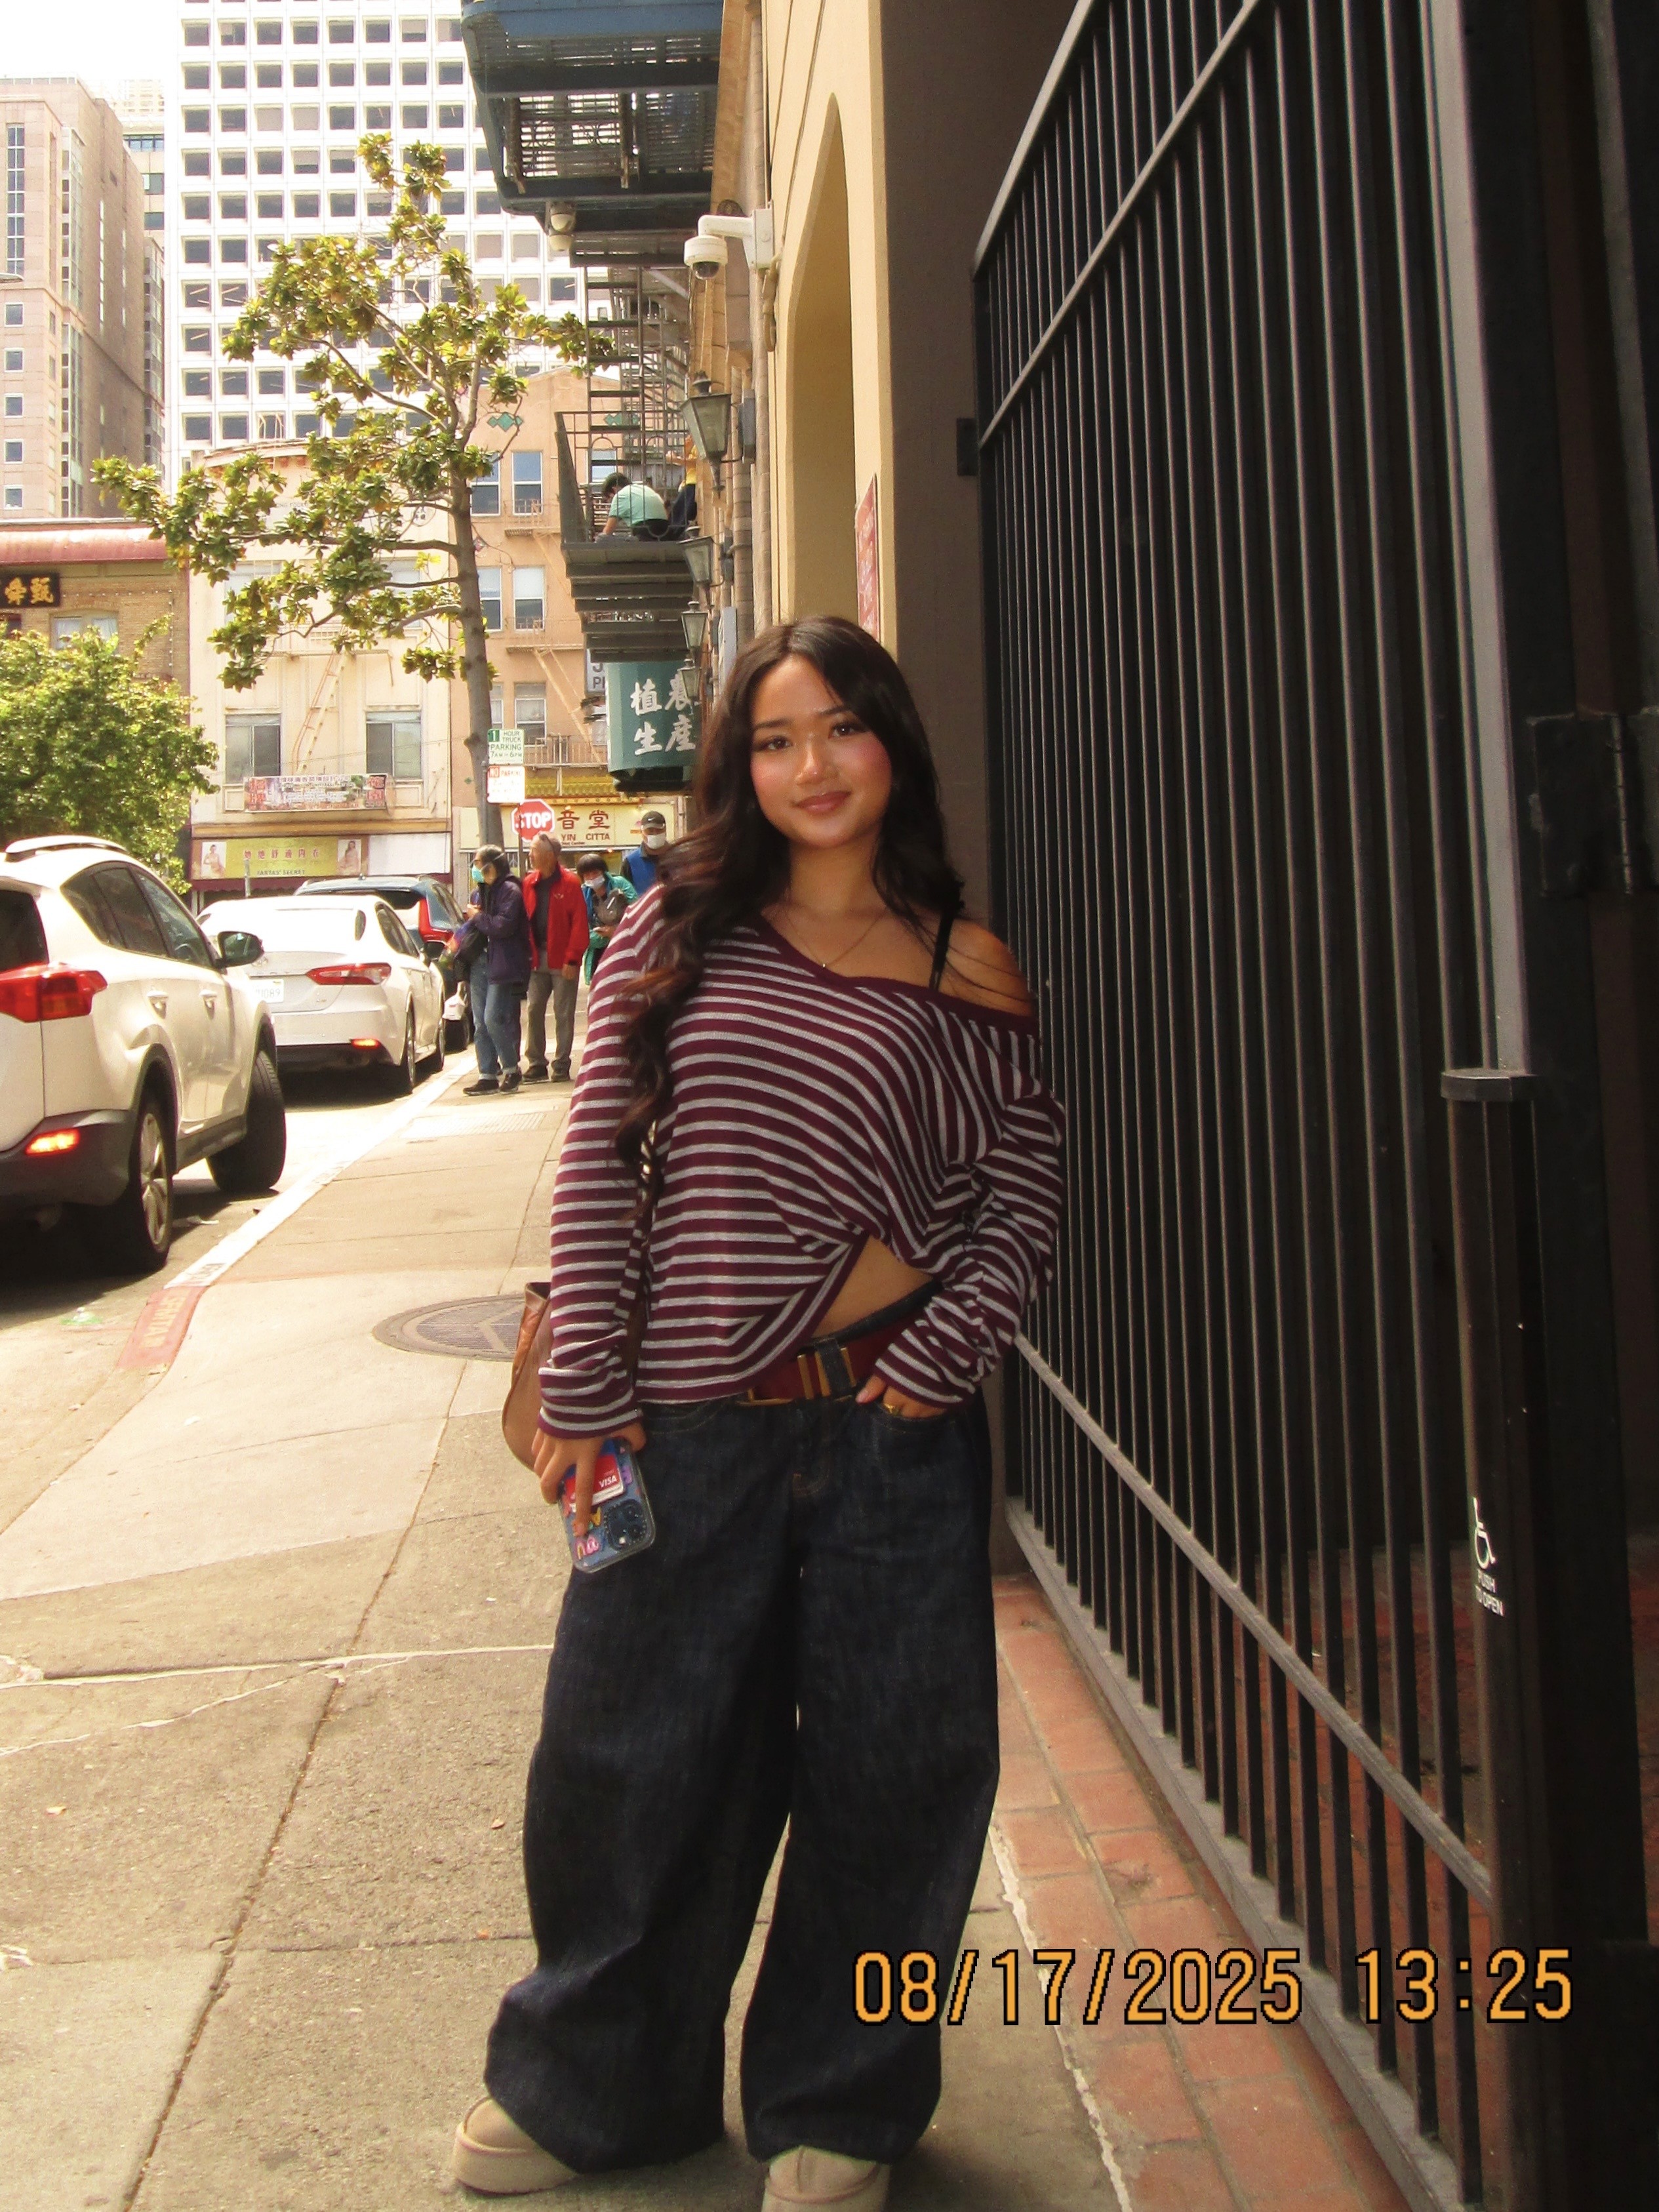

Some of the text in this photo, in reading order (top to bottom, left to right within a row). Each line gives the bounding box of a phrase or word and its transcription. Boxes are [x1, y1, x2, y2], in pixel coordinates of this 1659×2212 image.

[492, 730, 496, 742] 1
[515, 812, 552, 829] STOP
[599, 1475, 617, 1488] VISA
